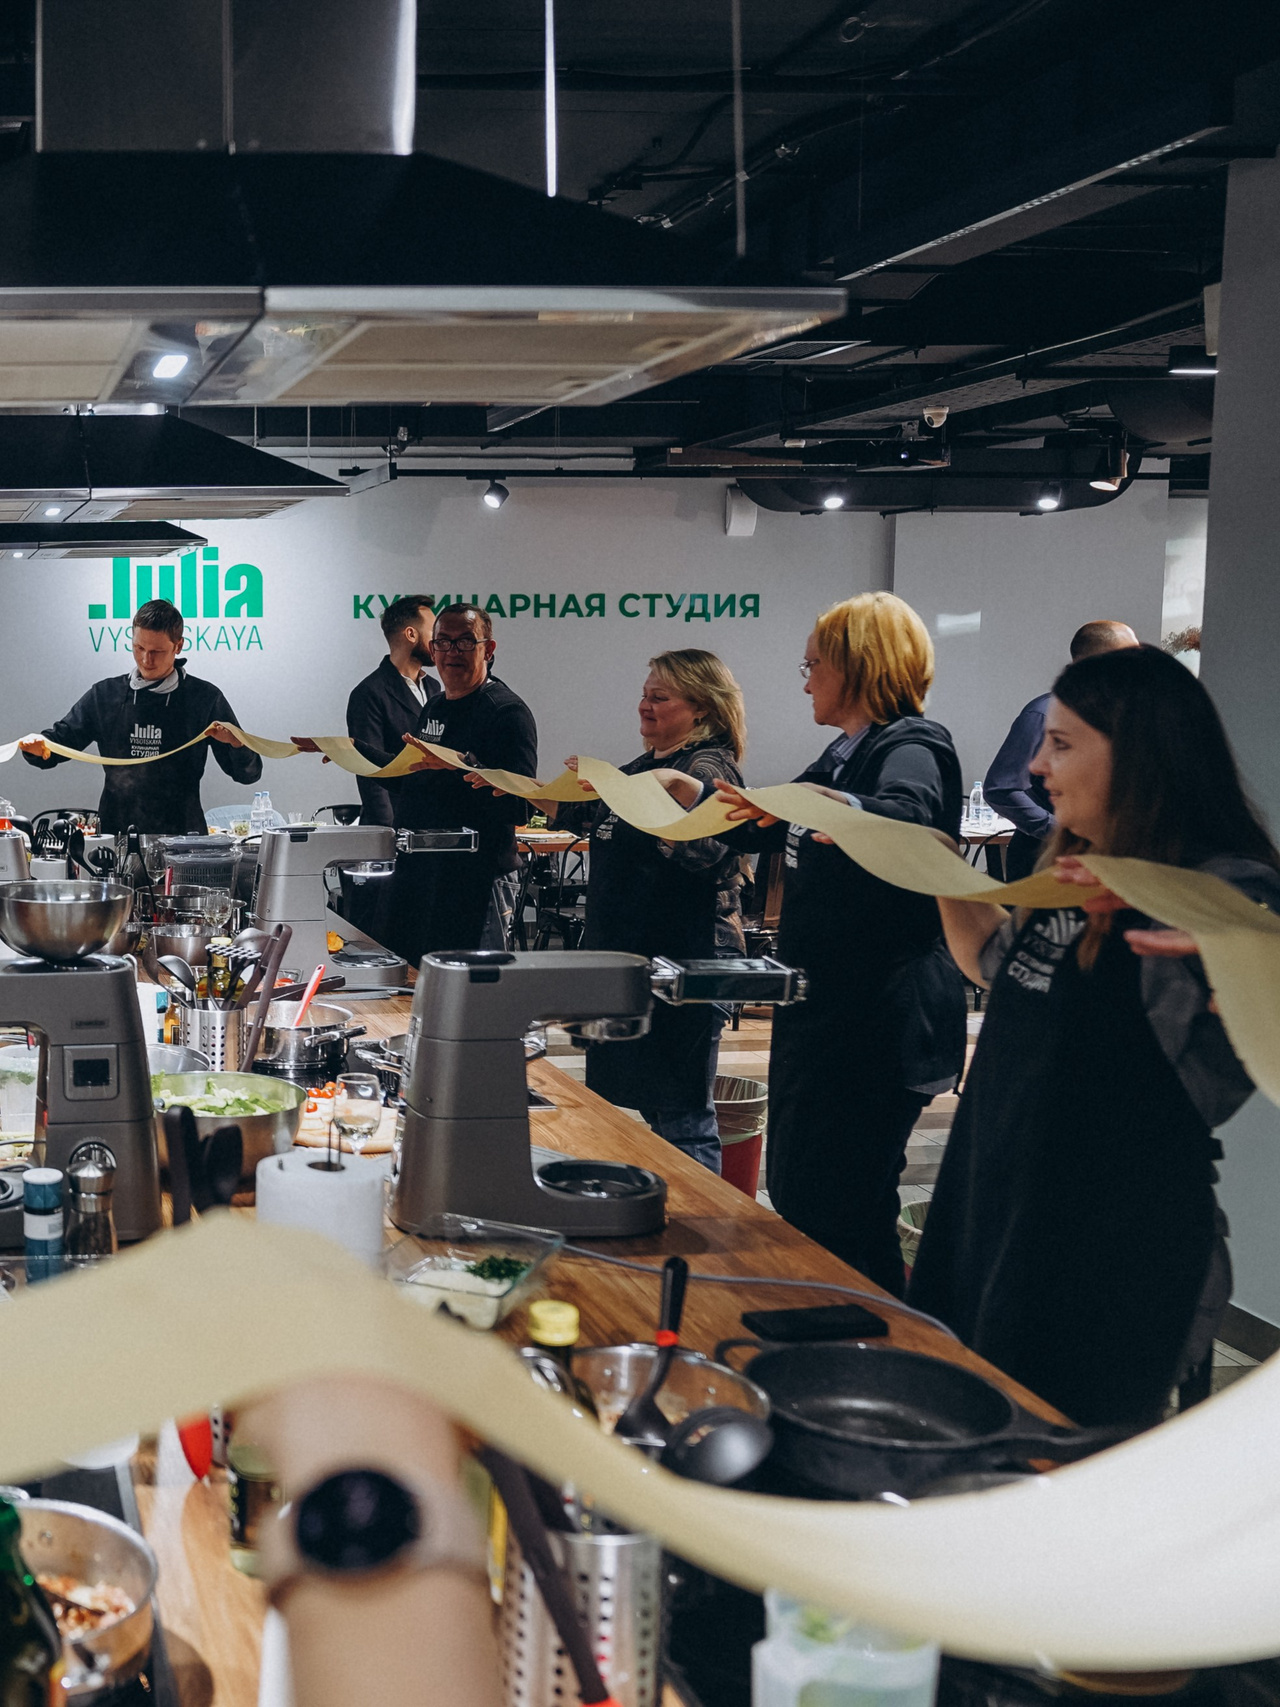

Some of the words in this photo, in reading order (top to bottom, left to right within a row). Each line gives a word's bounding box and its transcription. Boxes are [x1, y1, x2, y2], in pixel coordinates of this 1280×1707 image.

[88, 546, 264, 619] Julia
[618, 593, 760, 622] СТУДИЯ
[88, 625, 264, 652] VYSSKAYA
[129, 723, 162, 739] Julia
[130, 749, 160, 758] СТУДИЯ
